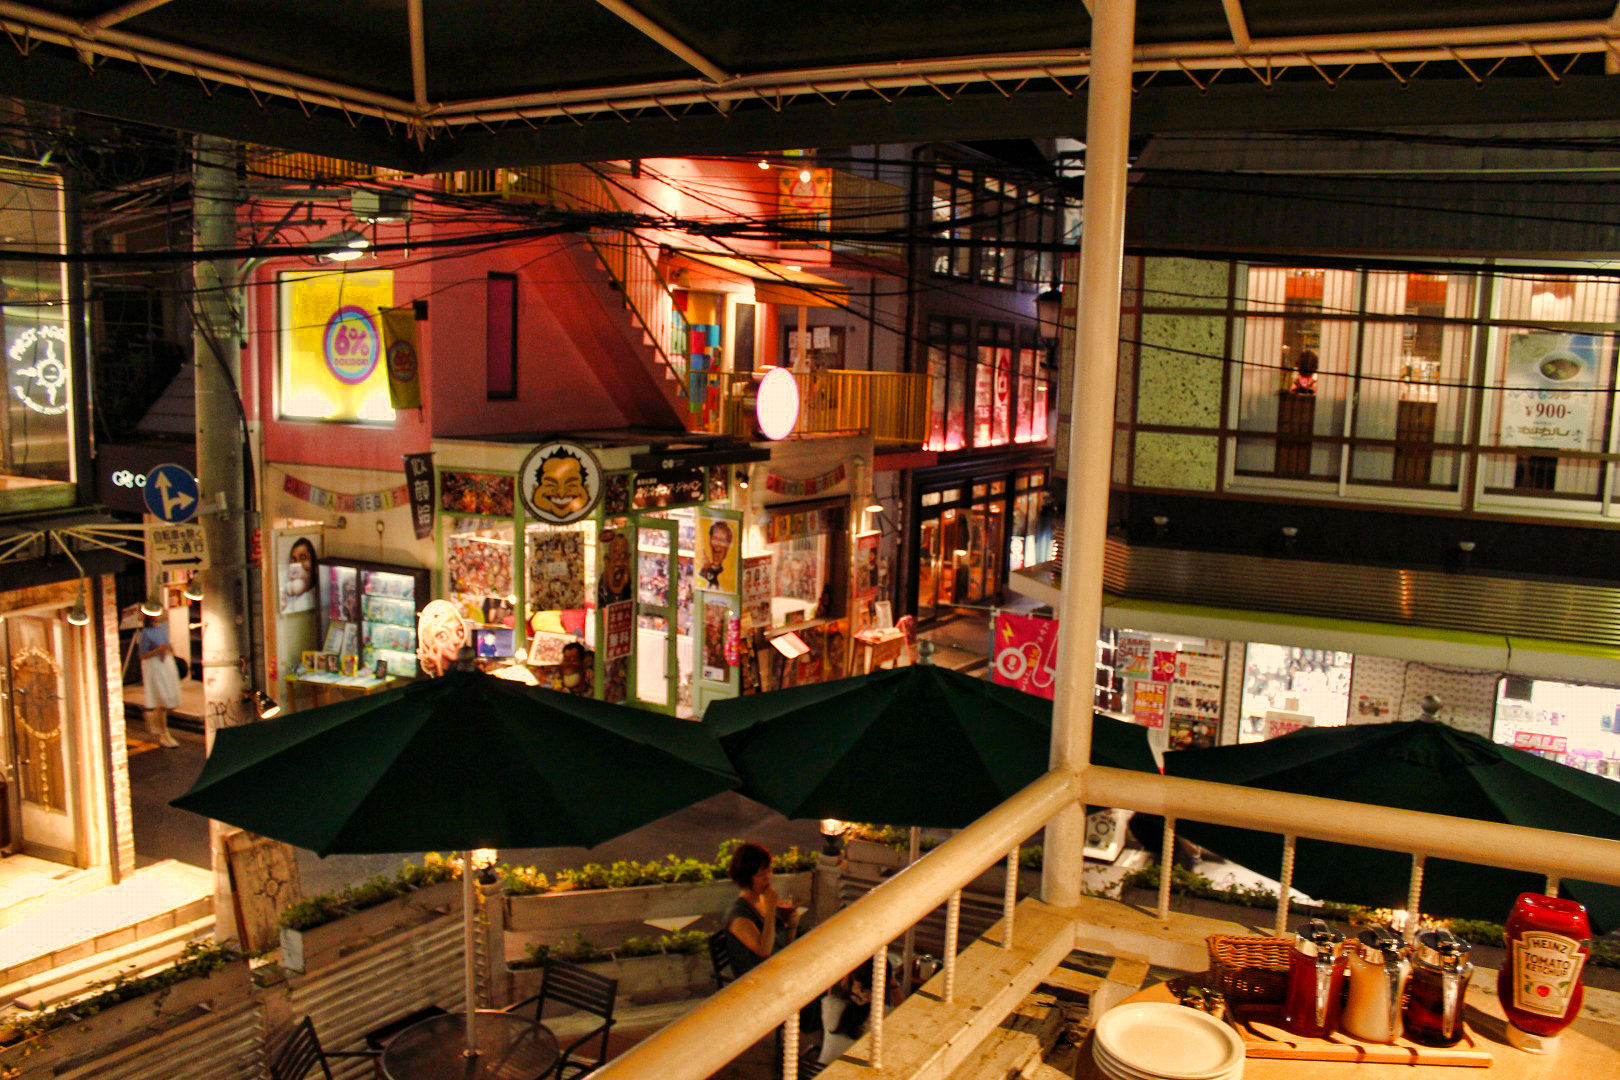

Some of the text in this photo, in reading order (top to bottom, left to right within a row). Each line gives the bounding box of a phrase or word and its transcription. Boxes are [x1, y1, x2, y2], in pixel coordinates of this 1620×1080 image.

[334, 323, 370, 357] 6%
[155, 541, 205, 554] 一方通行
[1118, 643, 1151, 657] SALE
[1517, 733, 1566, 752] SALE
[1531, 938, 1570, 954] HEINZ
[1525, 951, 1571, 970] TOMATO
[1525, 963, 1568, 977] KETCHUP
